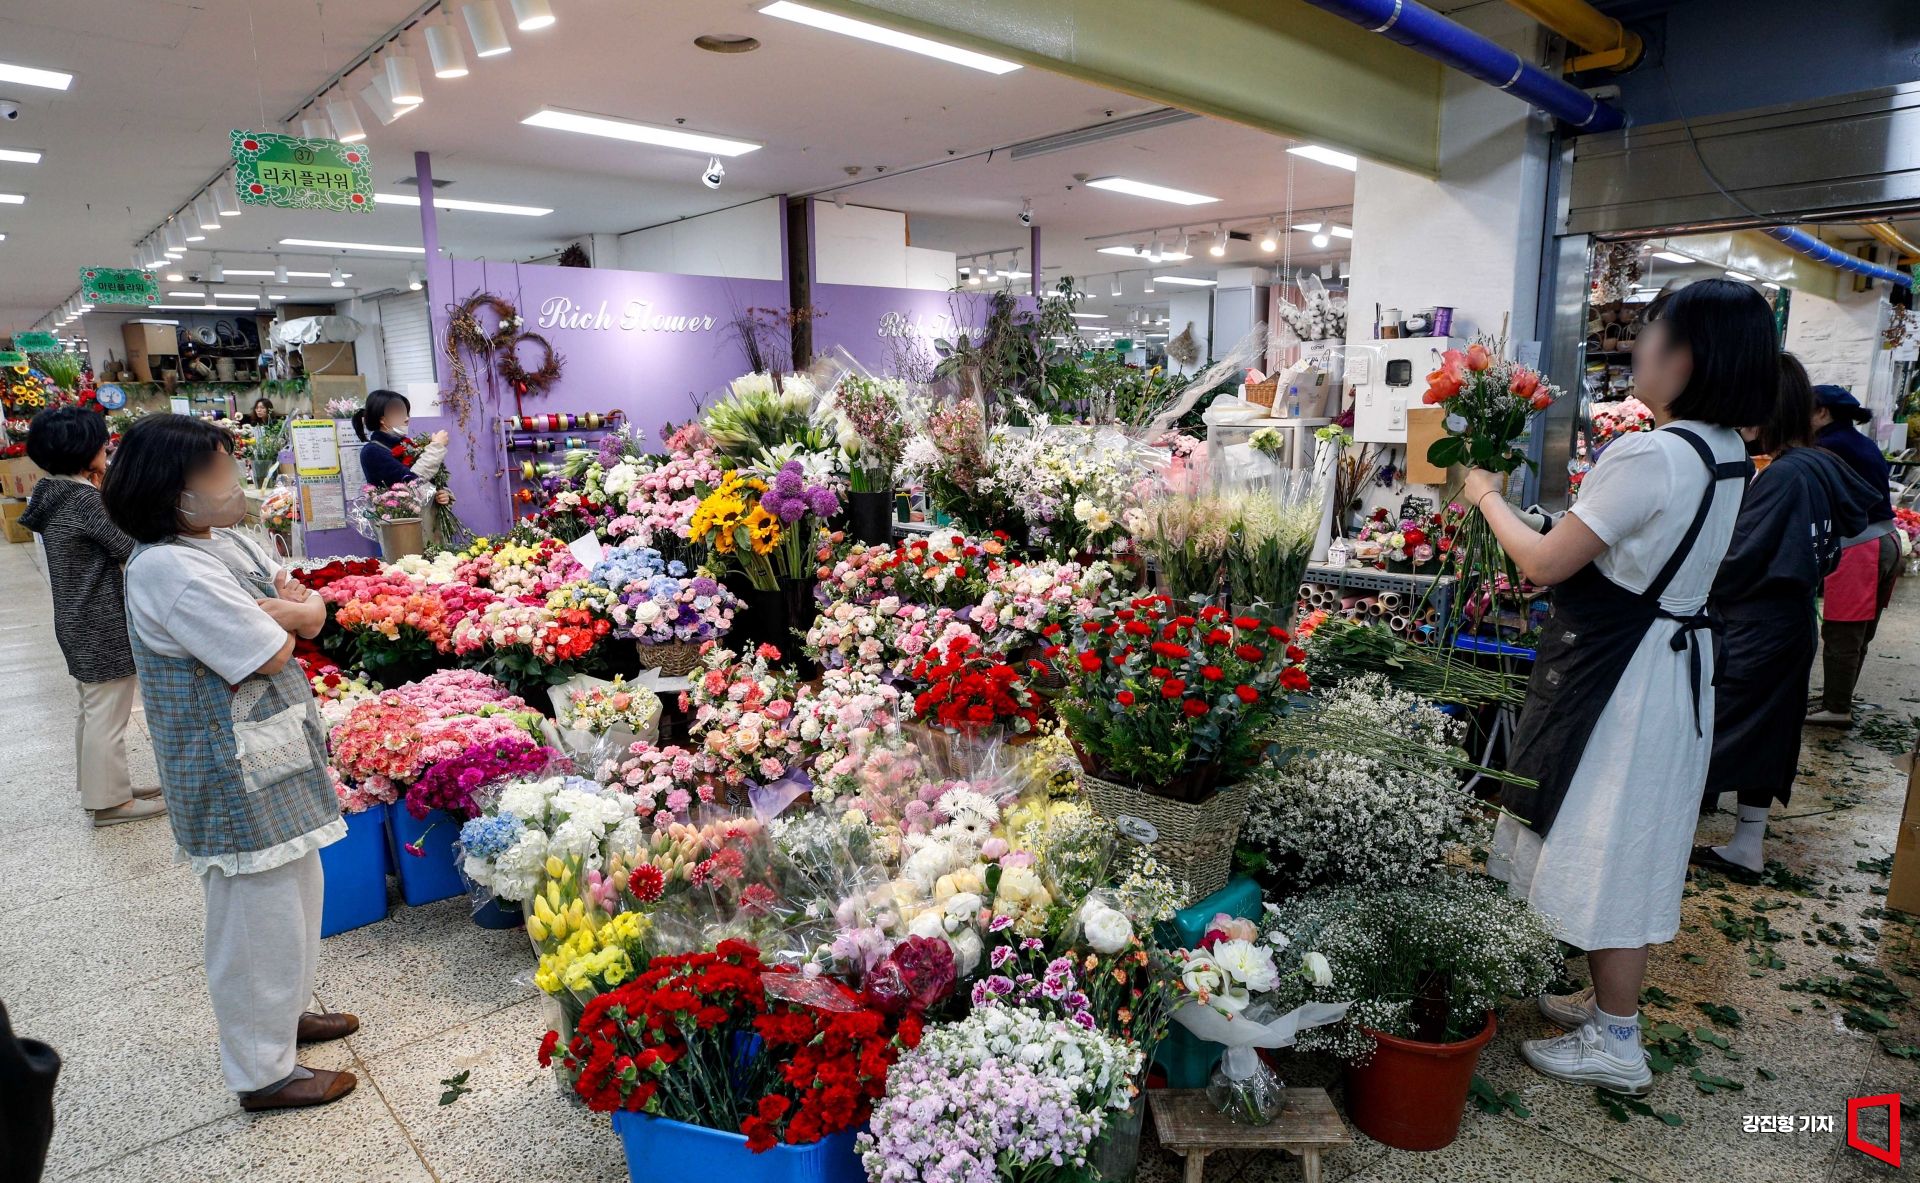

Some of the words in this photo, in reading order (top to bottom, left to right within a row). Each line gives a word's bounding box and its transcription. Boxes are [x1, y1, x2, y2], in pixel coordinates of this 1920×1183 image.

[297, 149, 312, 162] 37
[263, 167, 349, 190] 리치플라워
[538, 296, 615, 330] Rich
[619, 297, 718, 333] Flower
[878, 311, 927, 338] Rich
